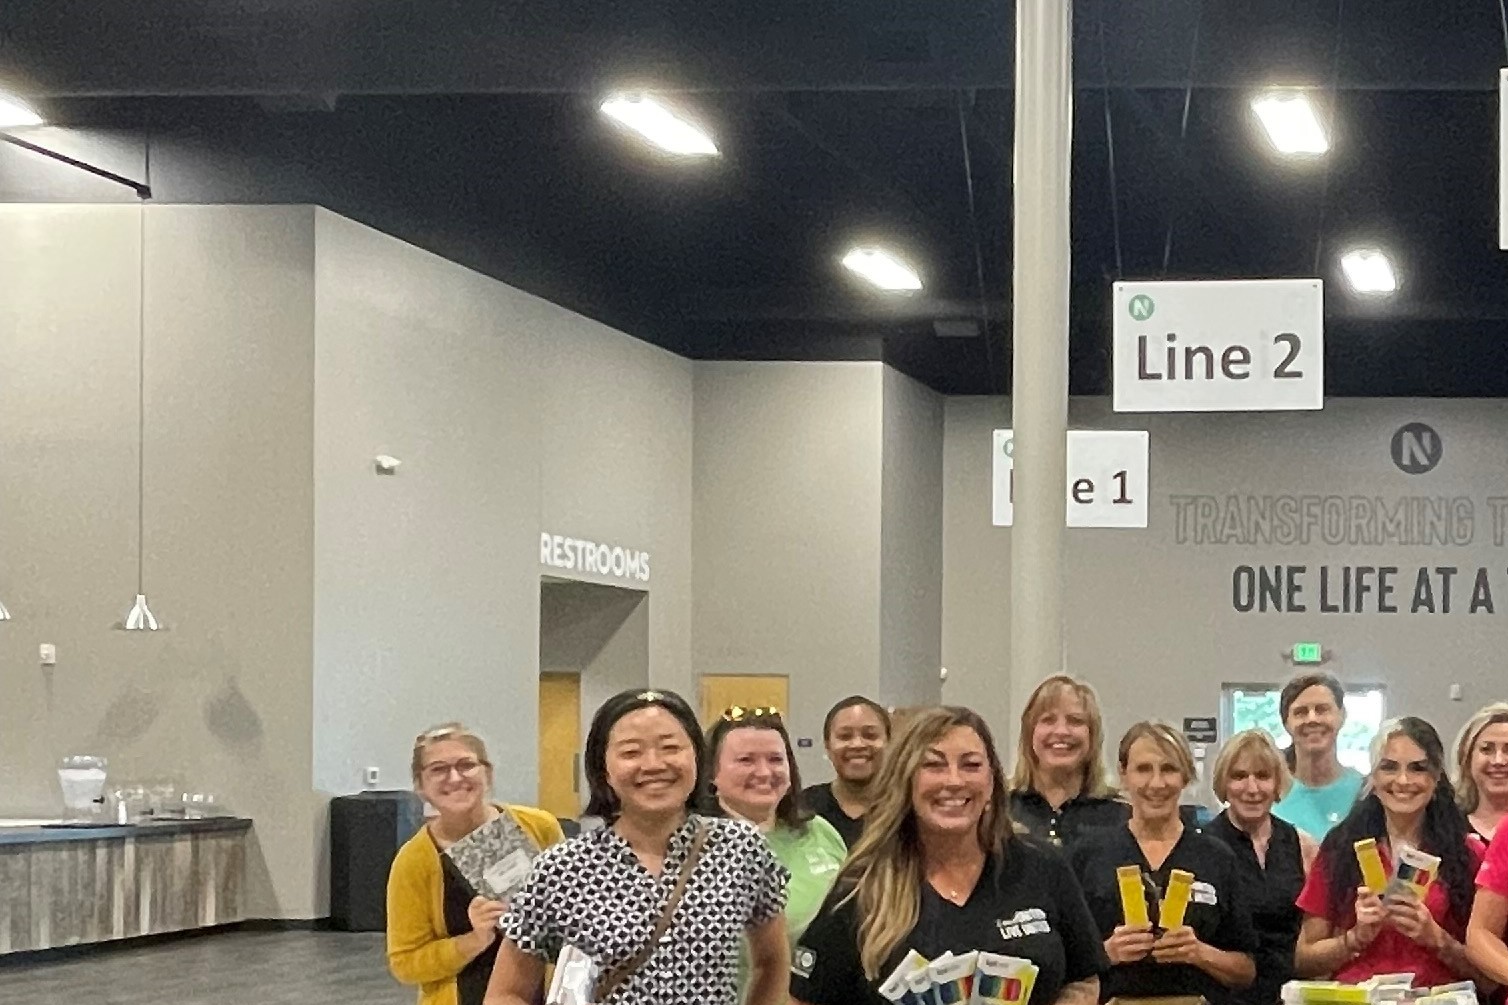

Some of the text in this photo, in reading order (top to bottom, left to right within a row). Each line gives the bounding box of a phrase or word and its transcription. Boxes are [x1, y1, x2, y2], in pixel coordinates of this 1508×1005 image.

[1137, 332, 1304, 381] Line 2
[1111, 469, 1134, 505] 1
[1169, 494, 1475, 547] TRANSFORMING
[540, 532, 651, 582] RESTROOMS
[1232, 564, 1307, 613] ONE
[1319, 565, 1399, 613] LIFE
[1410, 566, 1458, 614] AT
[1469, 566, 1495, 614] A
